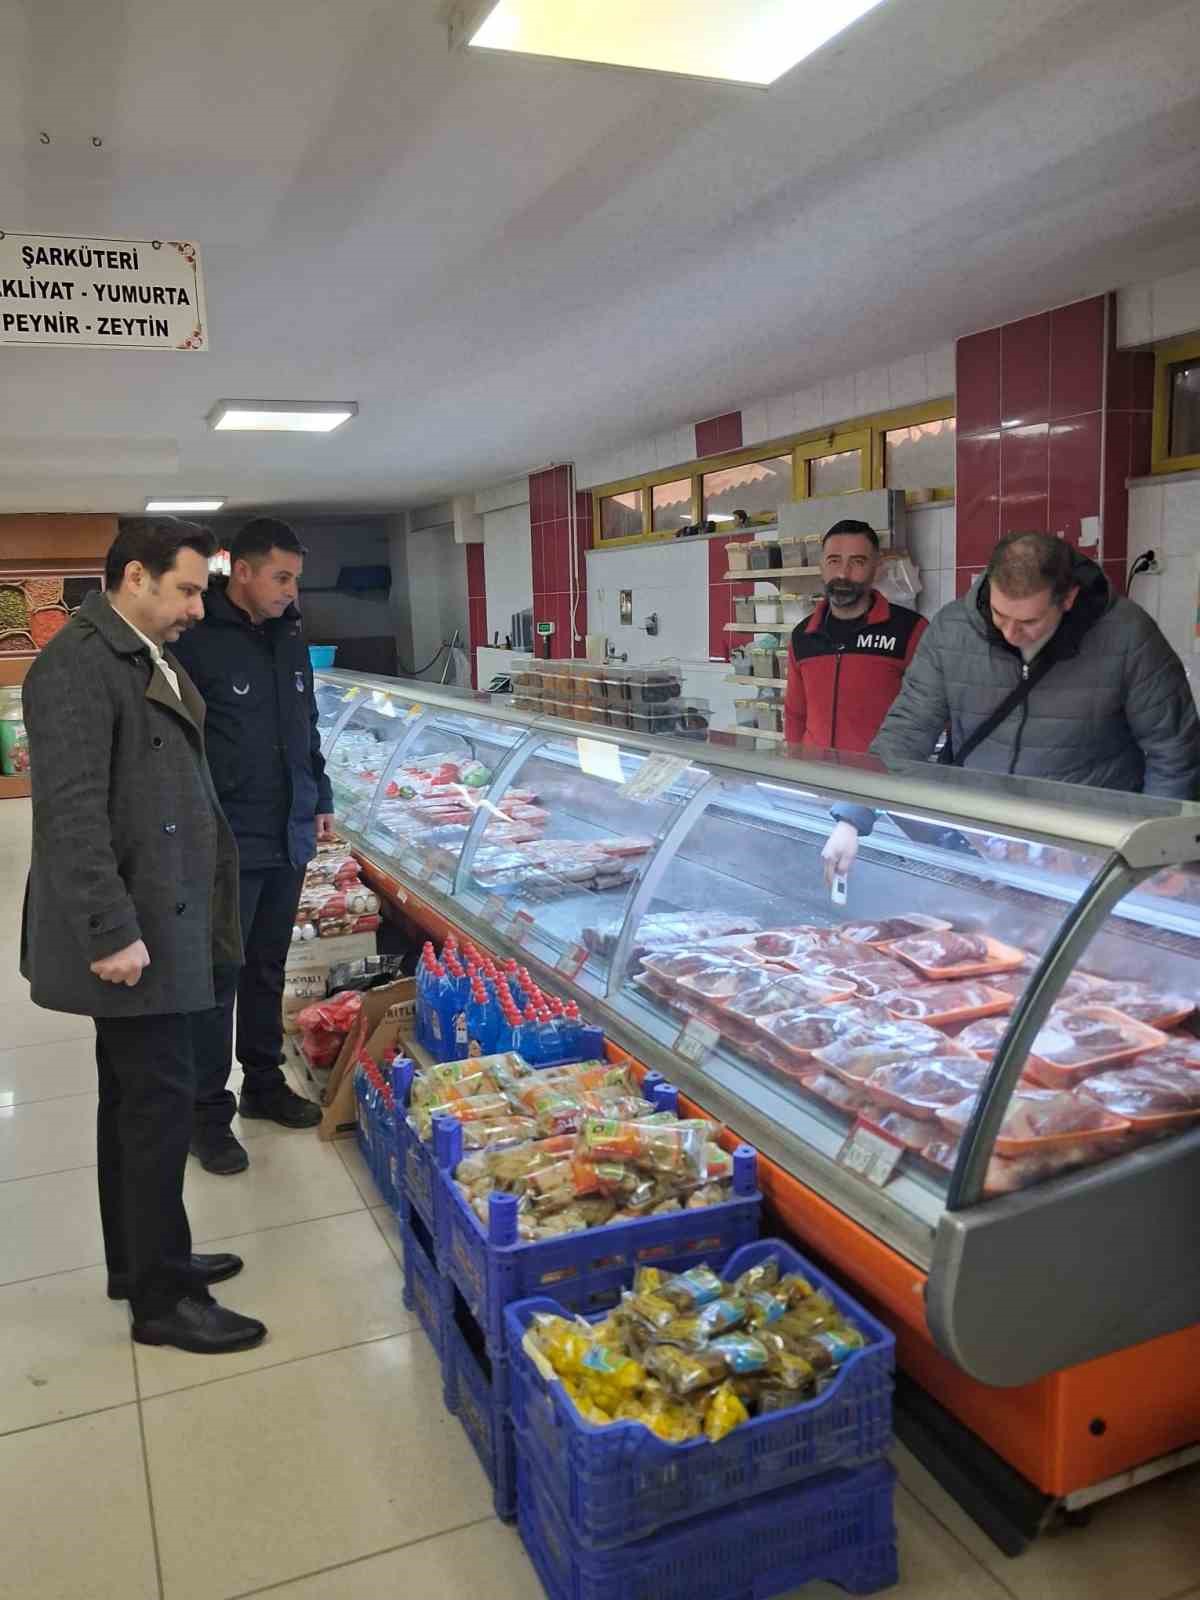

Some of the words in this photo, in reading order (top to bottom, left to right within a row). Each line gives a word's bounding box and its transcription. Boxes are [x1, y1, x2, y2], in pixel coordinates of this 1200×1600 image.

[22, 245, 139, 270] ŞARKÜTERİ
[0, 276, 75, 300] KLİYAT
[93, 283, 190, 306] YUMURTA
[3, 311, 80, 334] PEYNİR
[97, 314, 169, 337] ZEYTİN
